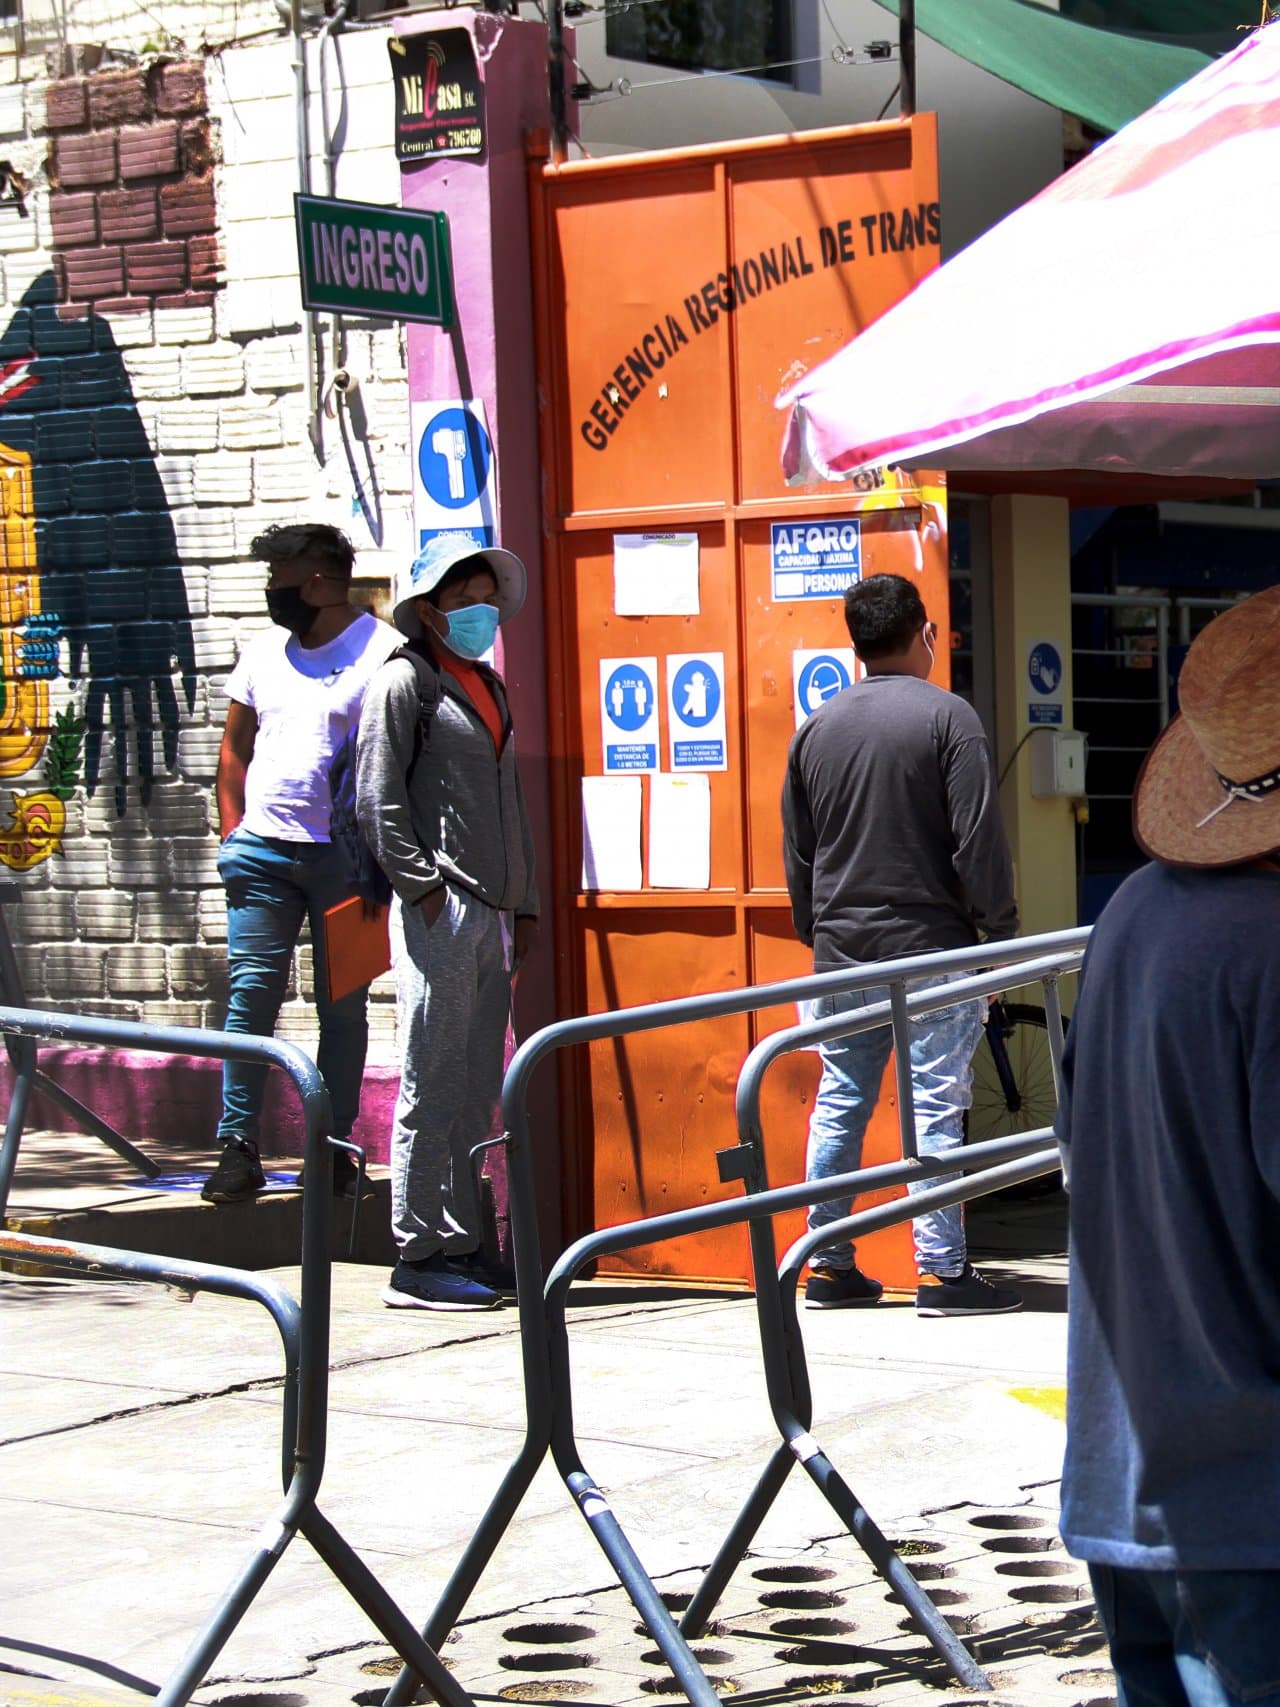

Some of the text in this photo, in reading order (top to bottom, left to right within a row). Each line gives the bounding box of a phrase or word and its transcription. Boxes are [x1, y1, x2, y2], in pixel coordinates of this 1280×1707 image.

[401, 138, 434, 153] Central
[311, 222, 429, 296] INGRESO
[581, 202, 940, 451] GERENCIA REGIONAL DE TRANS
[775, 525, 858, 554] AFORO
[778, 554, 821, 567] CAPACIDAD
[804, 572, 858, 592] PERSONAS
[625, 760, 648, 768] METROS
[642, 752, 650, 760] DE
